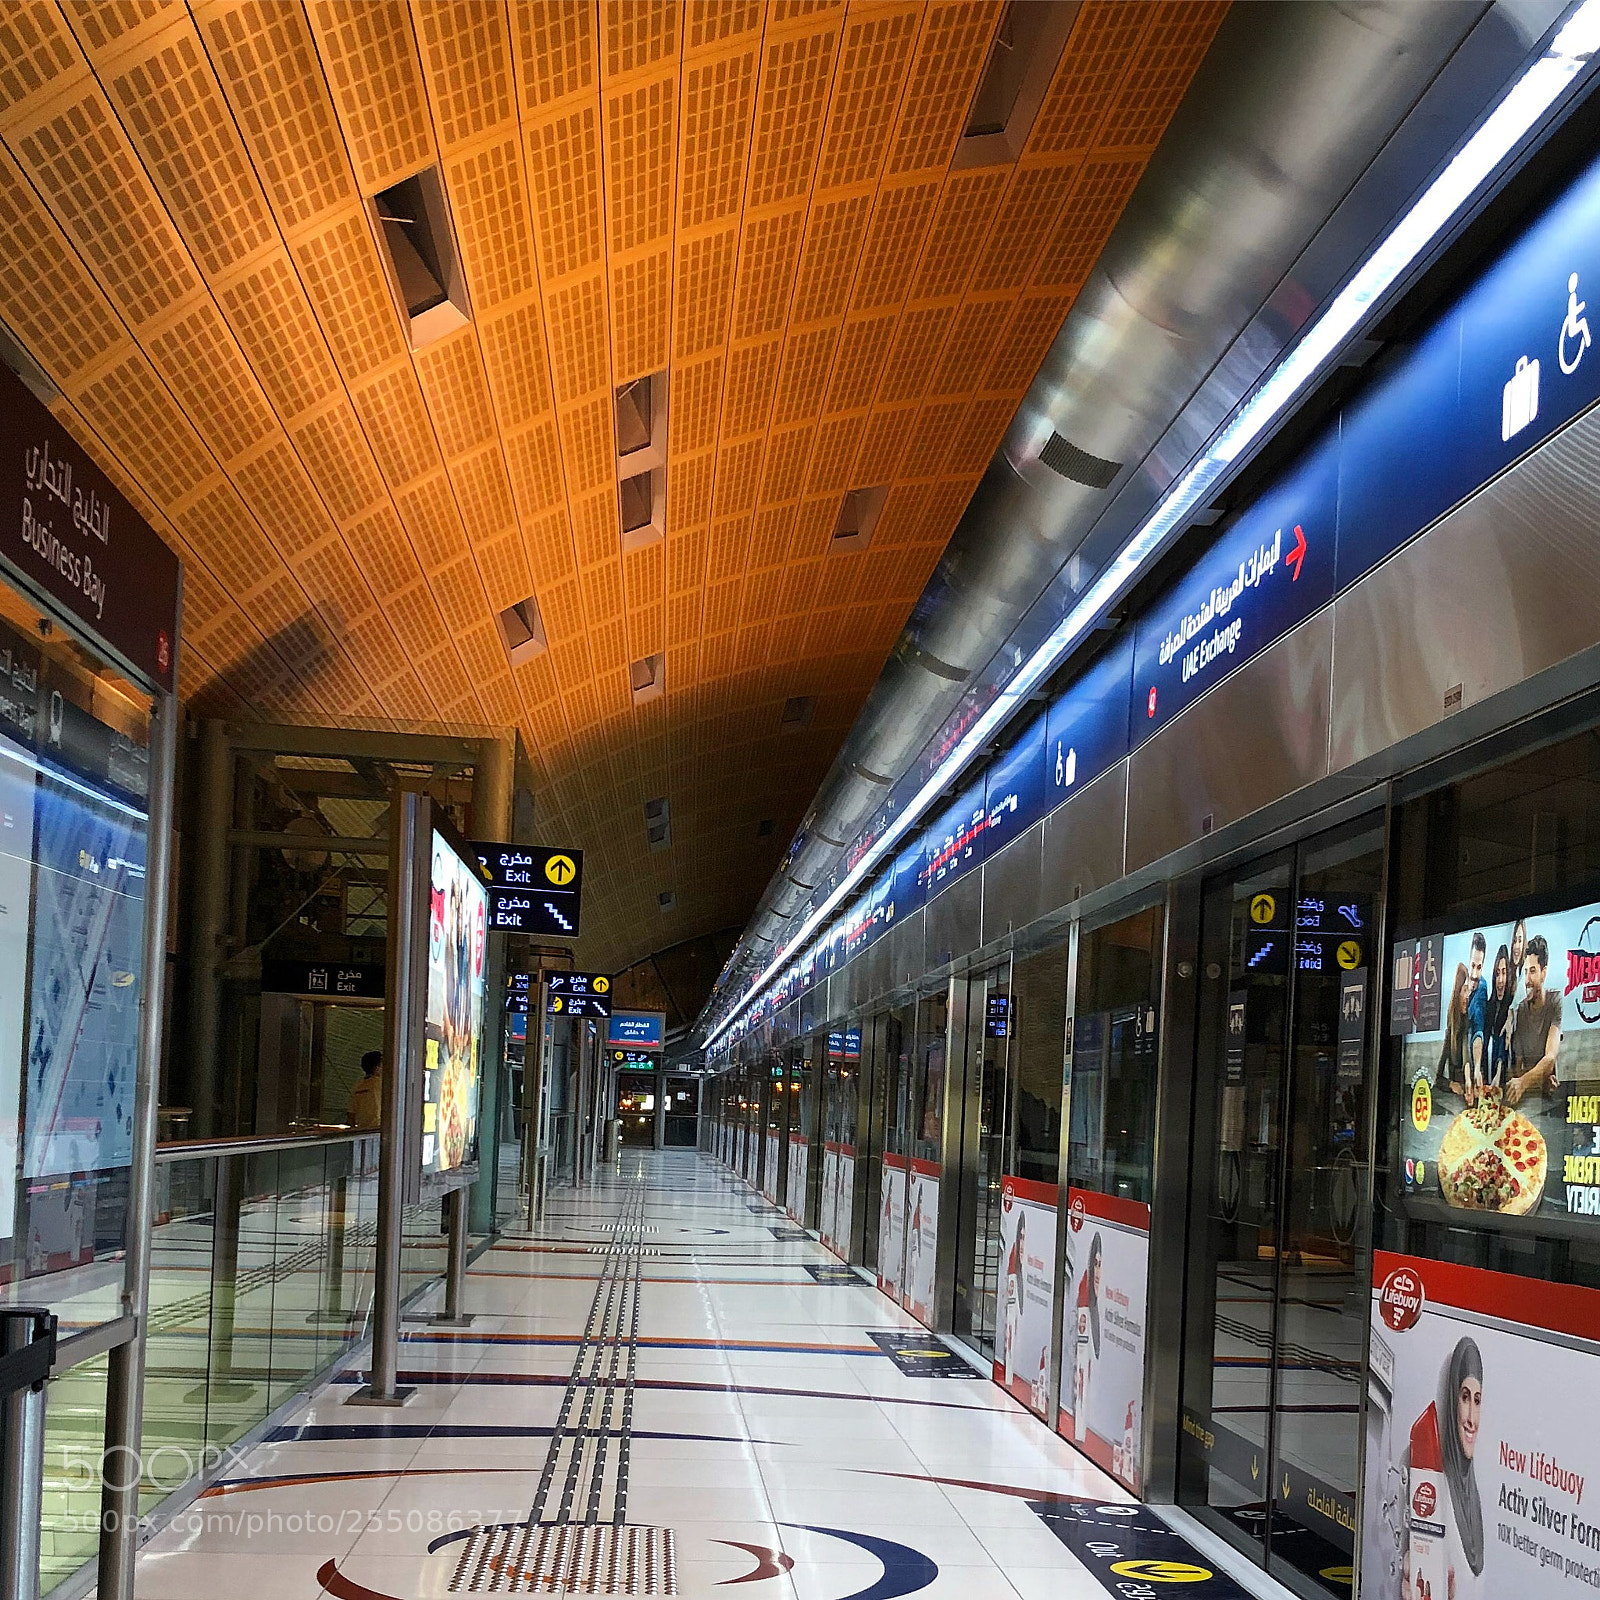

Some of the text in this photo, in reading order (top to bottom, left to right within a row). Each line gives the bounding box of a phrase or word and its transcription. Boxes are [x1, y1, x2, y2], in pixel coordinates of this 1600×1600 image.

[25, 439, 110, 545] الخليج التجاري
[22, 498, 106, 619] Business Bay
[1181, 617, 1241, 683] UAE Exchange
[499, 852, 532, 866] مخرج
[505, 869, 531, 883] Exit
[498, 896, 530, 910] مخرج
[496, 912, 522, 926] Exit
[338, 970, 362, 979] مخرج
[569, 975, 587, 984] مخرج
[336, 982, 355, 992] Exit
[572, 984, 586, 992] Exit
[568, 998, 586, 1006] مخرج
[568, 1006, 581, 1014] Exit
[1383, 1287, 1420, 1313] Lifebuoy
[1499, 1440, 1584, 1505] New Lifebuoy
[1498, 1482, 1528, 1518] Activ
[1530, 1495, 1568, 1536] Silver
[1085, 1541, 1124, 1558] Out
[1512, 1527, 1539, 1559] better
[1539, 1545, 1563, 1571] germ
